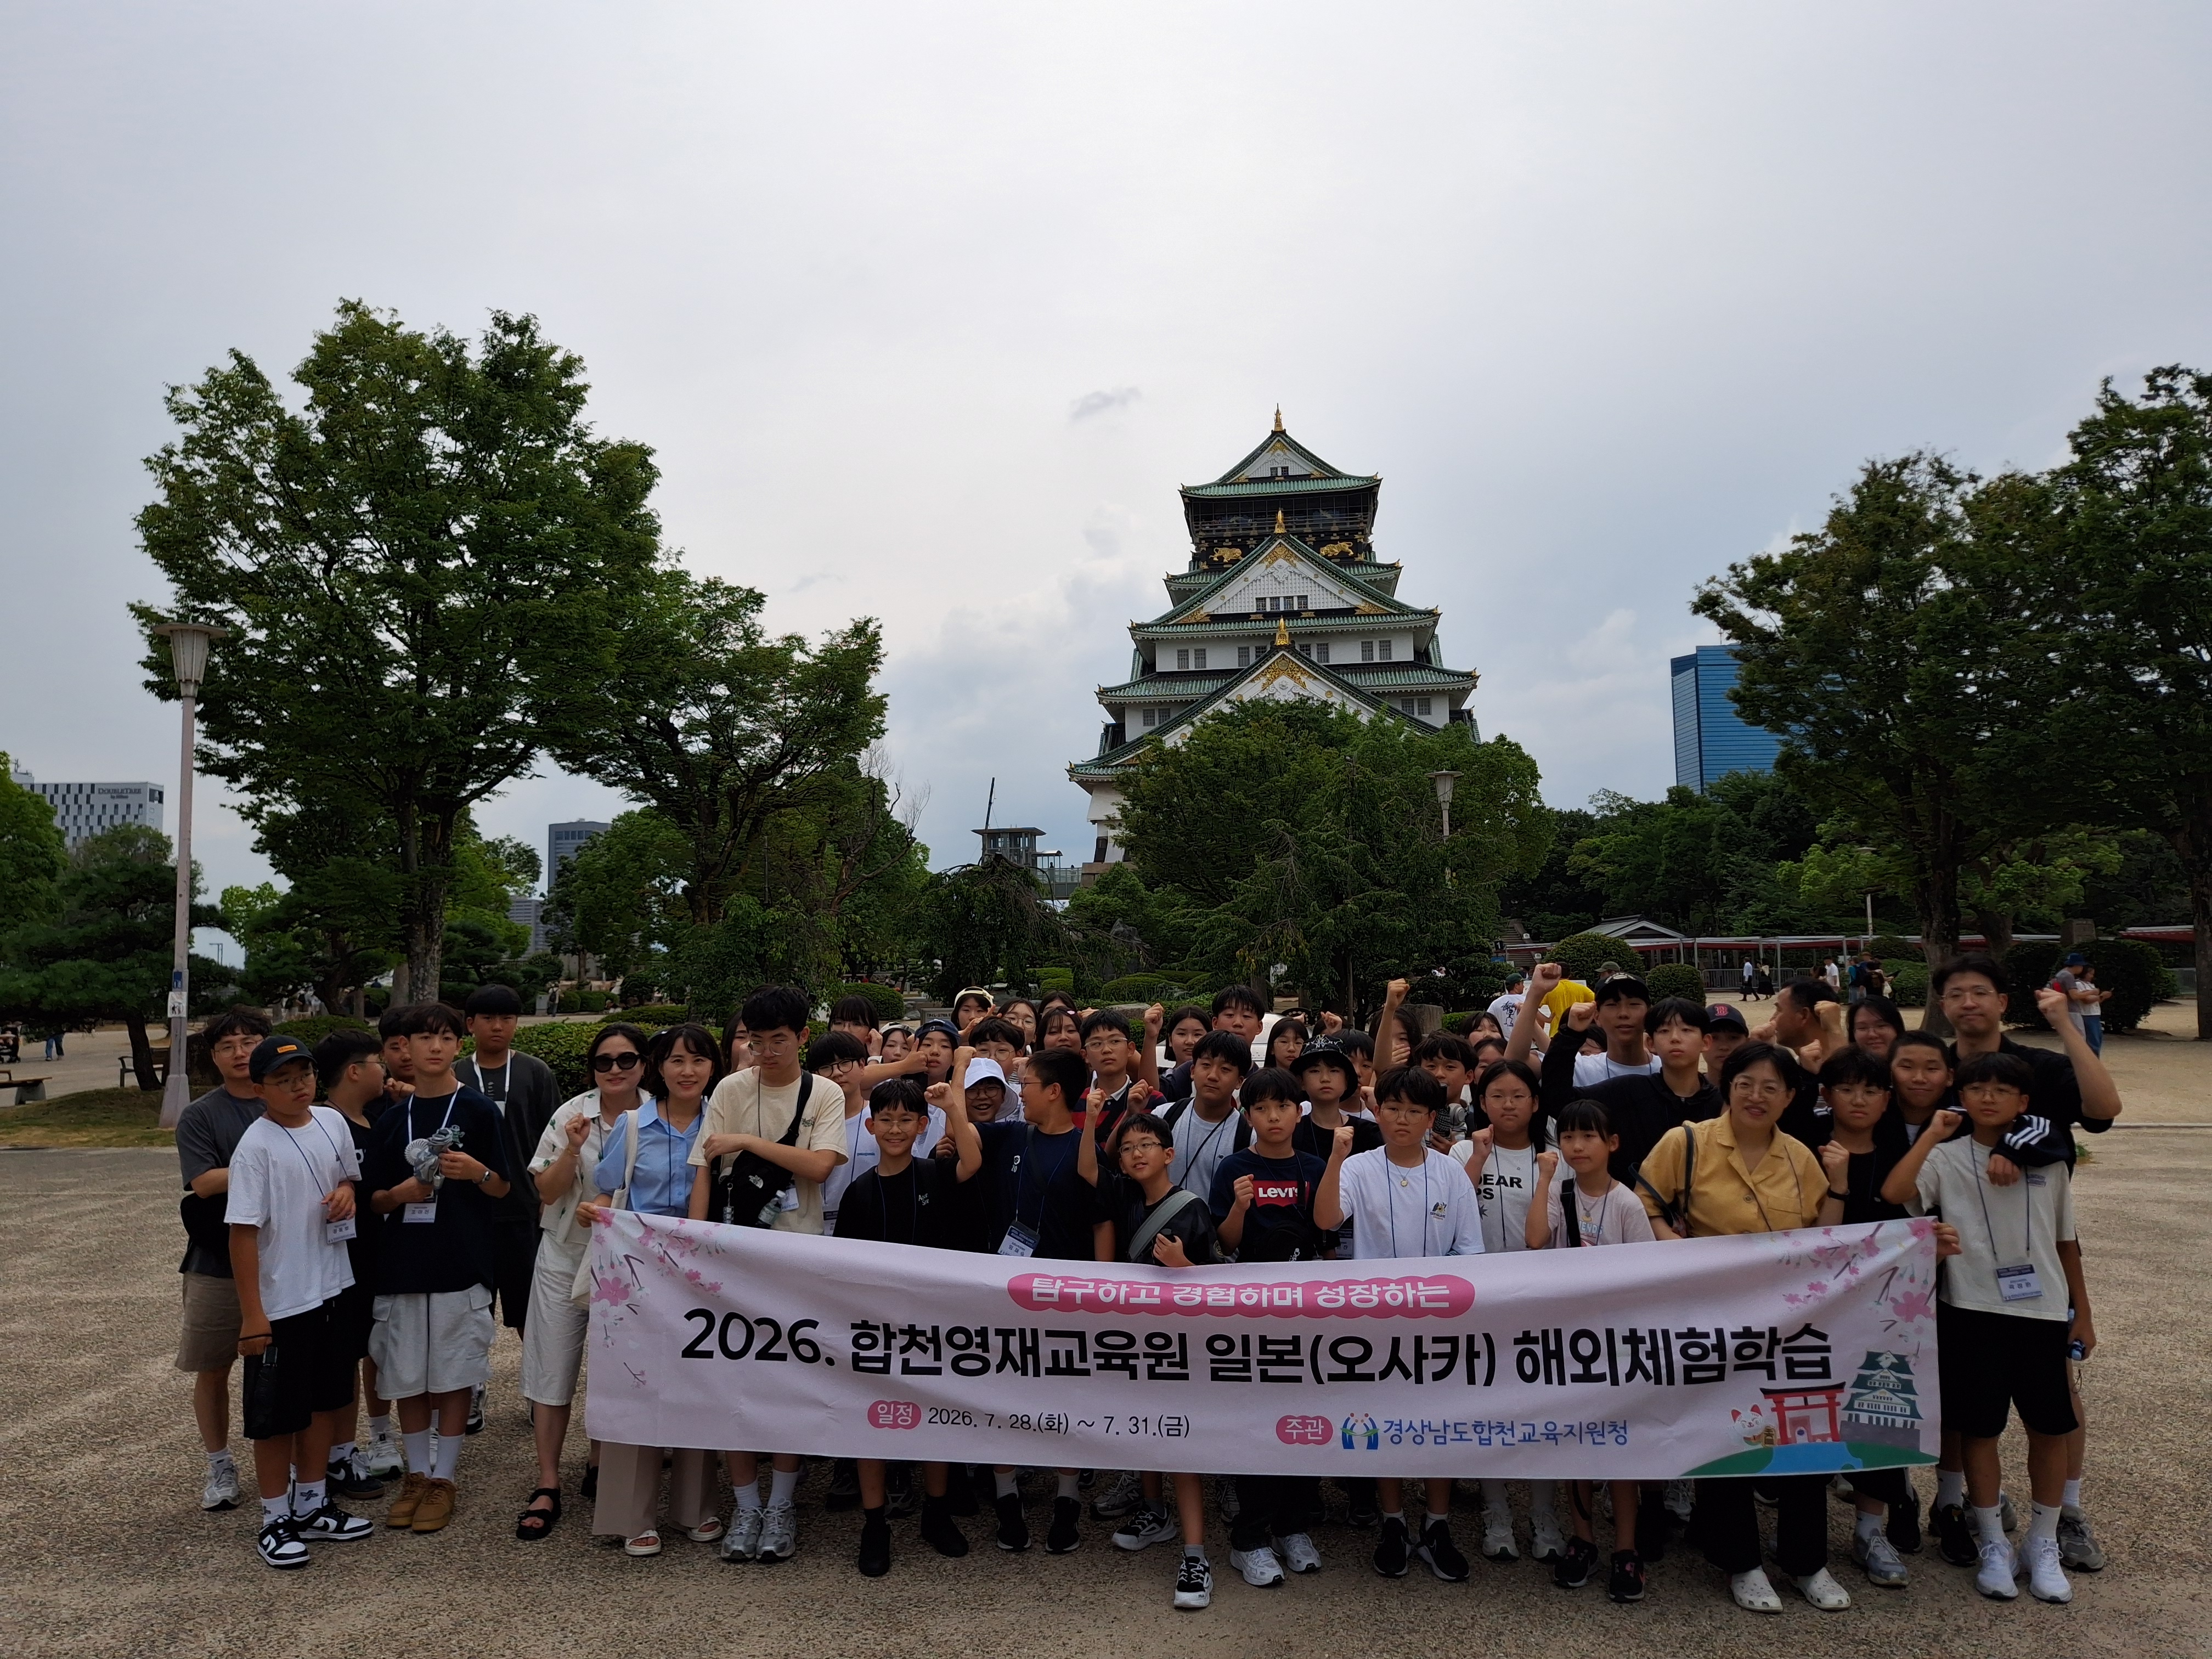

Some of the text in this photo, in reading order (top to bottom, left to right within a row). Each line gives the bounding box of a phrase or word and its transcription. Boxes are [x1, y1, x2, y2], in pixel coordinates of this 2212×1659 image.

[1032, 1277, 1450, 1308] 탐구하고 경험하며 성장하는
[681, 1308, 1831, 1387] 2026. 합천영재교육원 일본(오사카) 해외체험학습
[877, 1404, 912, 1425] 일정
[928, 1407, 978, 1427] 2026.
[984, 1413, 1002, 1429] 7.
[1009, 1412, 1069, 1435] 28.(화)
[1103, 1416, 1120, 1436] 7.
[1128, 1414, 1189, 1438] 31.(금)
[1285, 1419, 1627, 1446] 주관 경상남도합천교육지원청
